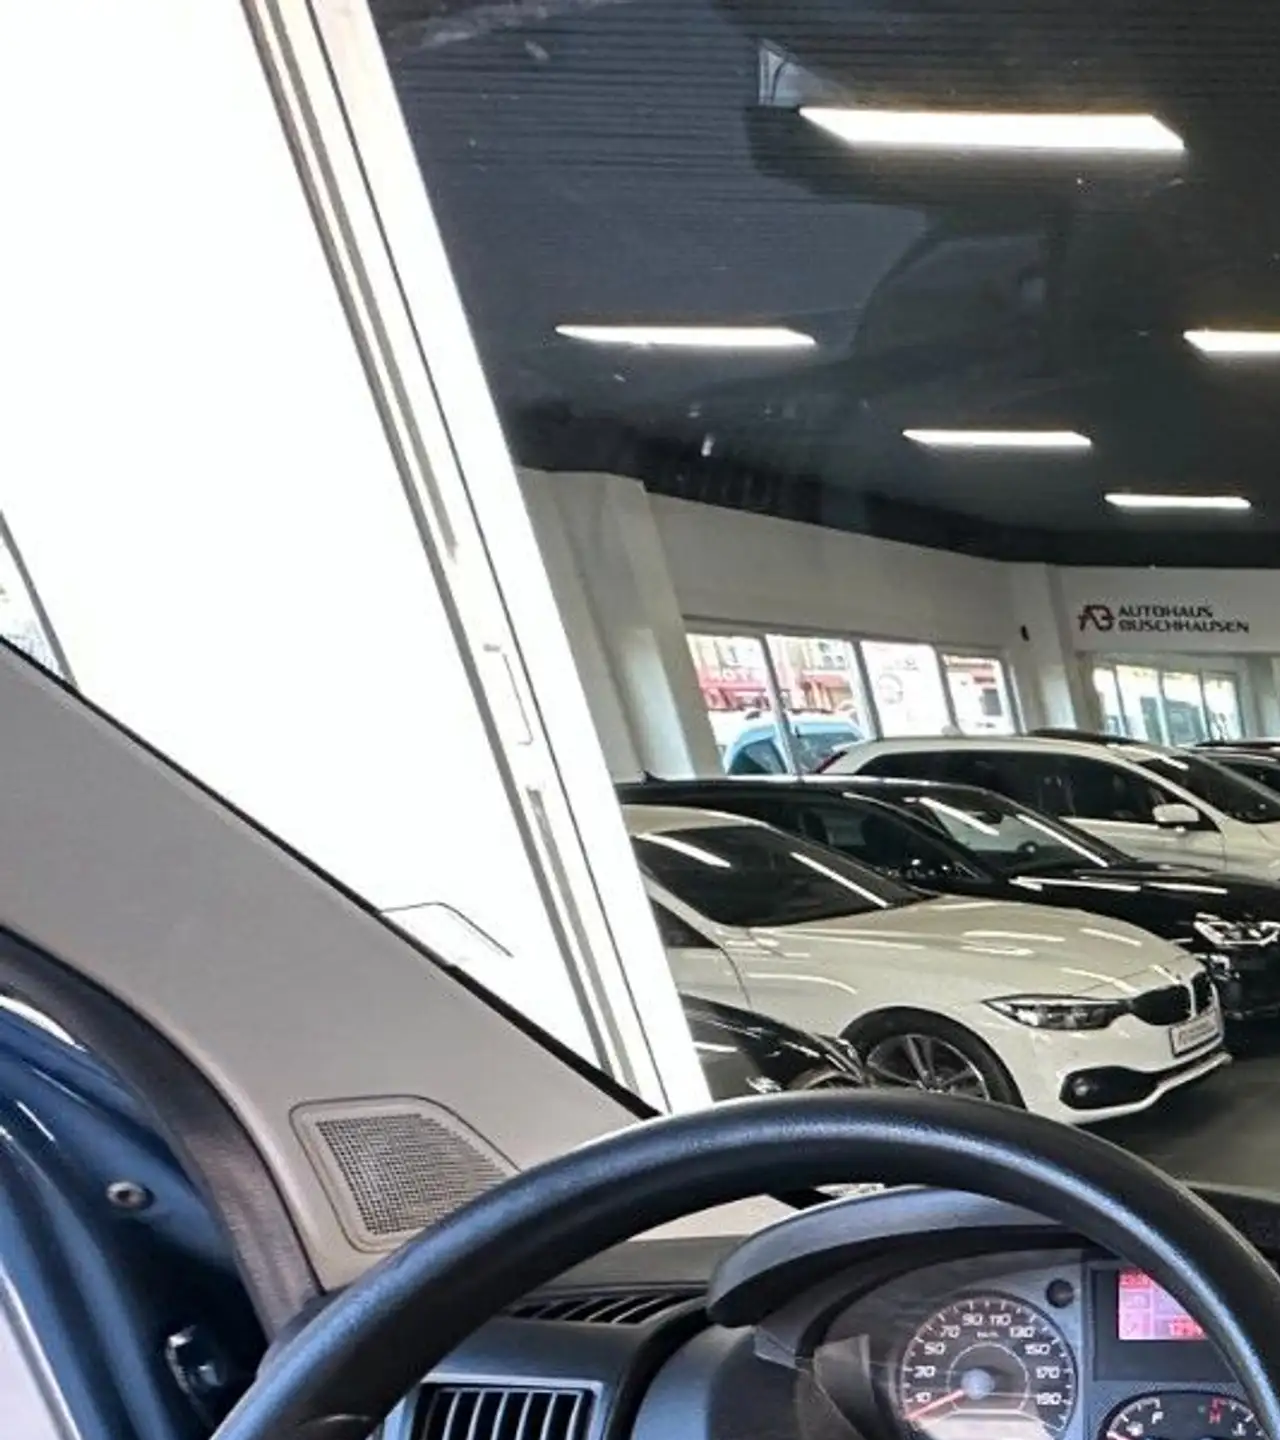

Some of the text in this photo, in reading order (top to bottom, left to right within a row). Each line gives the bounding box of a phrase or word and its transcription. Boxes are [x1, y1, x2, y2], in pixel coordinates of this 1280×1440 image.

[1118, 605, 1213, 618] AUTOHAUS
[1118, 619, 1249, 633] BUSCHHAUSEN
[962, 1313, 983, 1326] 90
[989, 1313, 1012, 1326] 110
[939, 1325, 961, 1338] 70
[1009, 1327, 1036, 1338] 130
[923, 1342, 946, 1355] 50
[1024, 1343, 1051, 1356] 150
[914, 1365, 936, 1378] 30
[1035, 1366, 1060, 1379] 170
[915, 1391, 932, 1403] 10
[1036, 1393, 1062, 1405] 190
